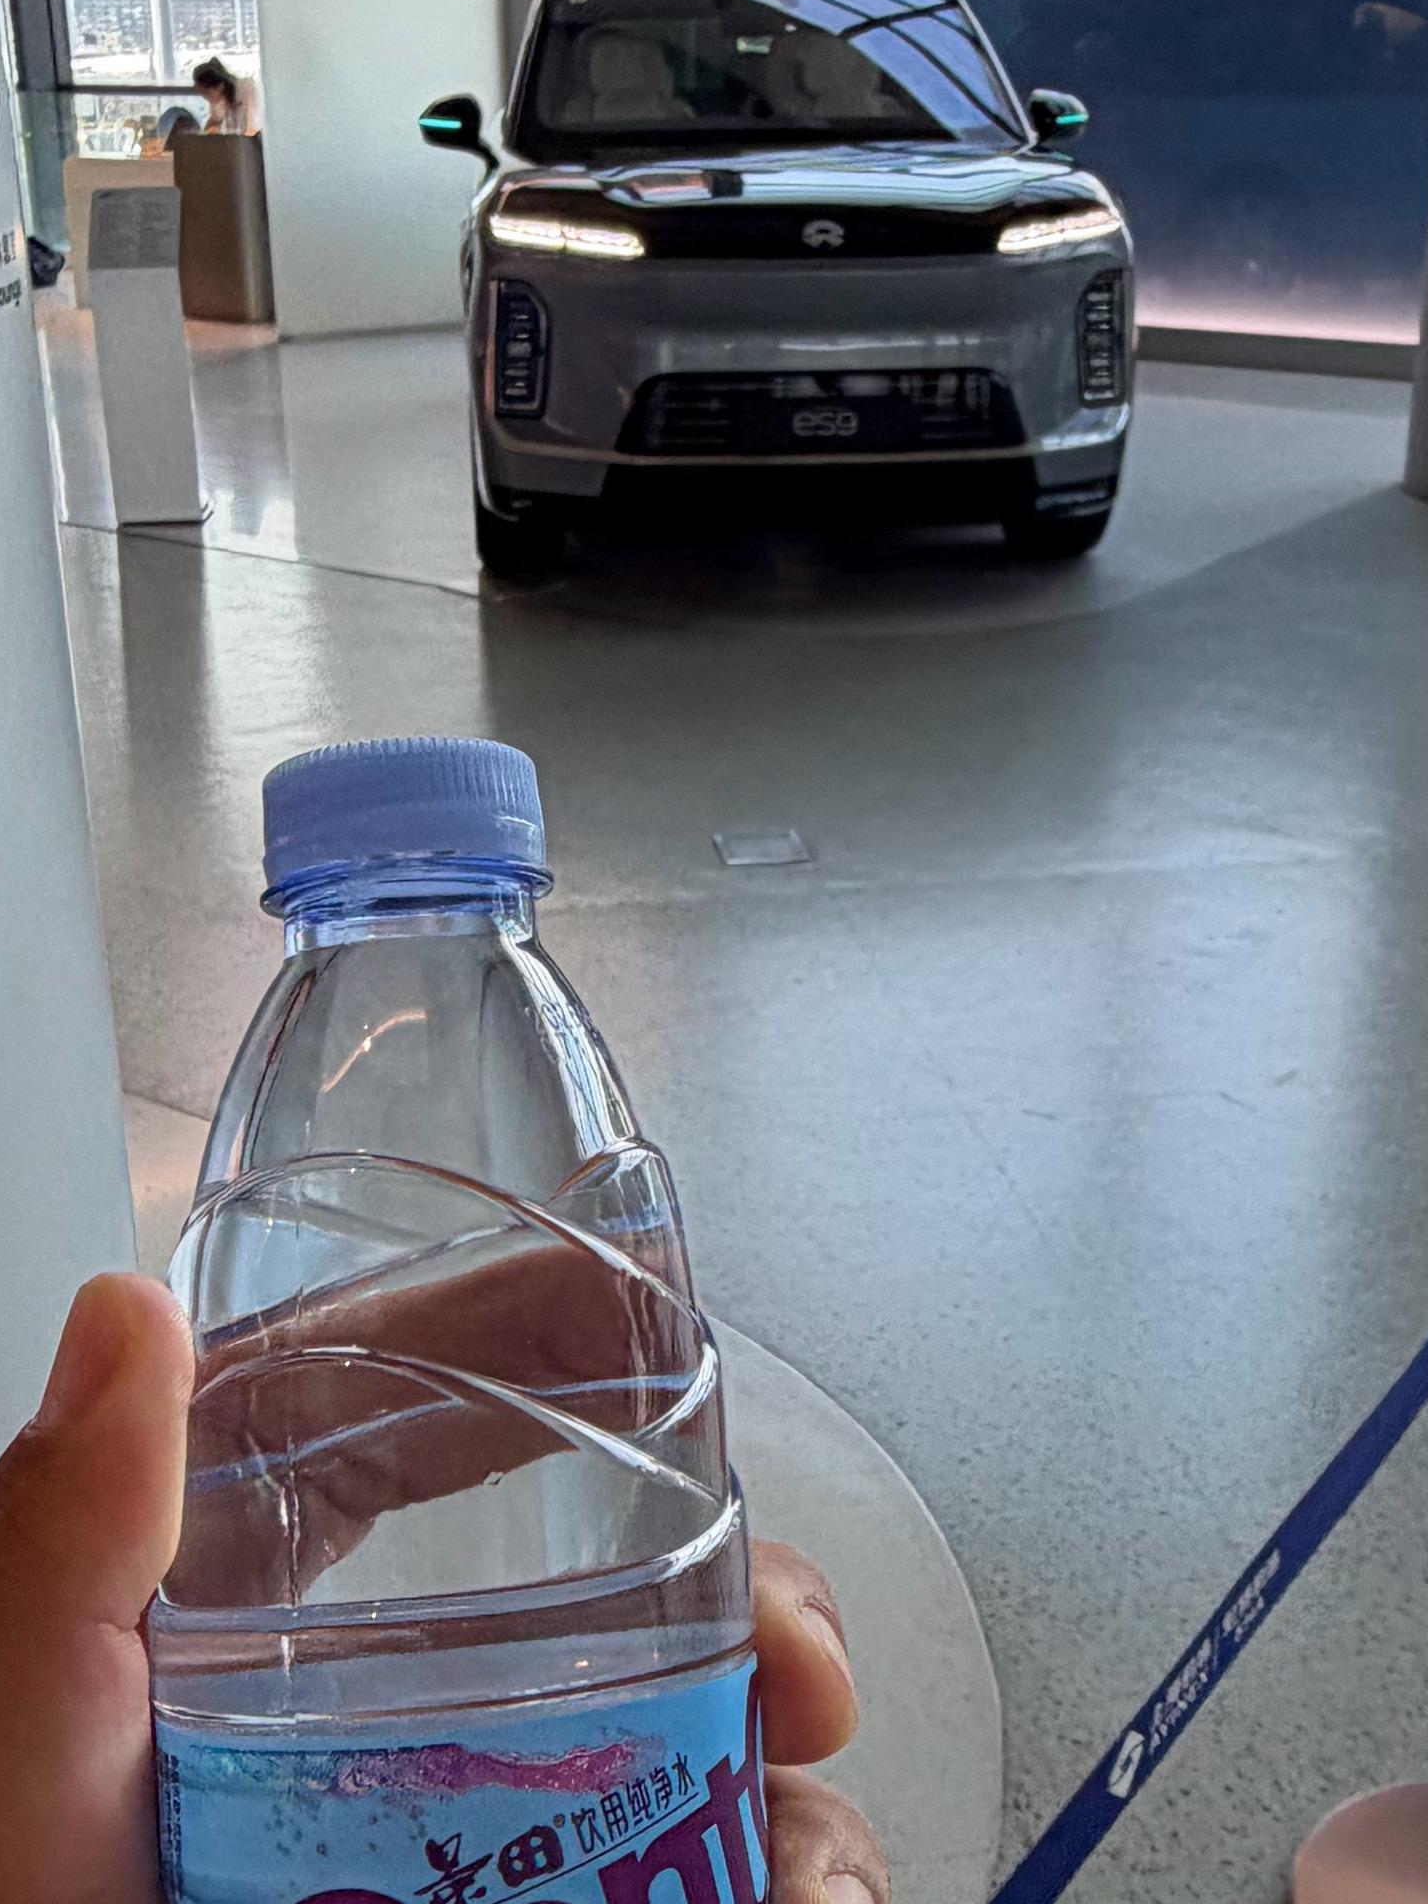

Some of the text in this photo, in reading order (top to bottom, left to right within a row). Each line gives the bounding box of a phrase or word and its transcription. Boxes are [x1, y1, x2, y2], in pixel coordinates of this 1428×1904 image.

[571, 1752, 695, 1854] 饮用纯净水
